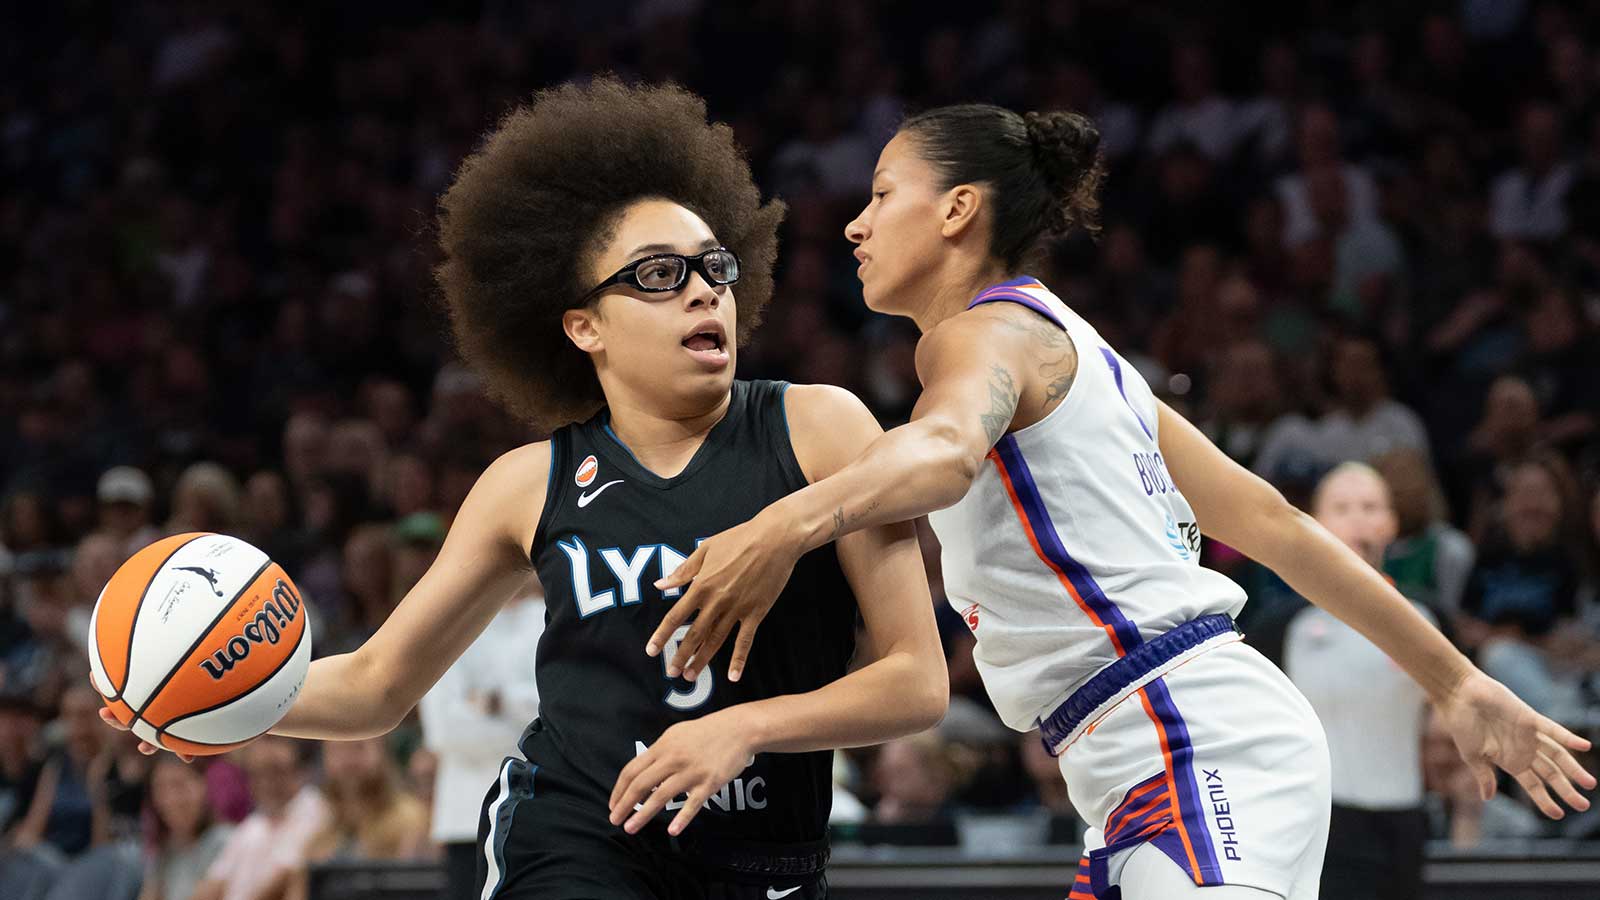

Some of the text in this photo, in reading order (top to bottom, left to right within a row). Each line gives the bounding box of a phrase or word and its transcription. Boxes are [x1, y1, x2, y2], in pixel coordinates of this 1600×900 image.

[557, 535, 710, 619] LYN
[199, 577, 300, 681] Wilson
[661, 621, 716, 712] 5
[1202, 768, 1242, 862] PHOENIX
